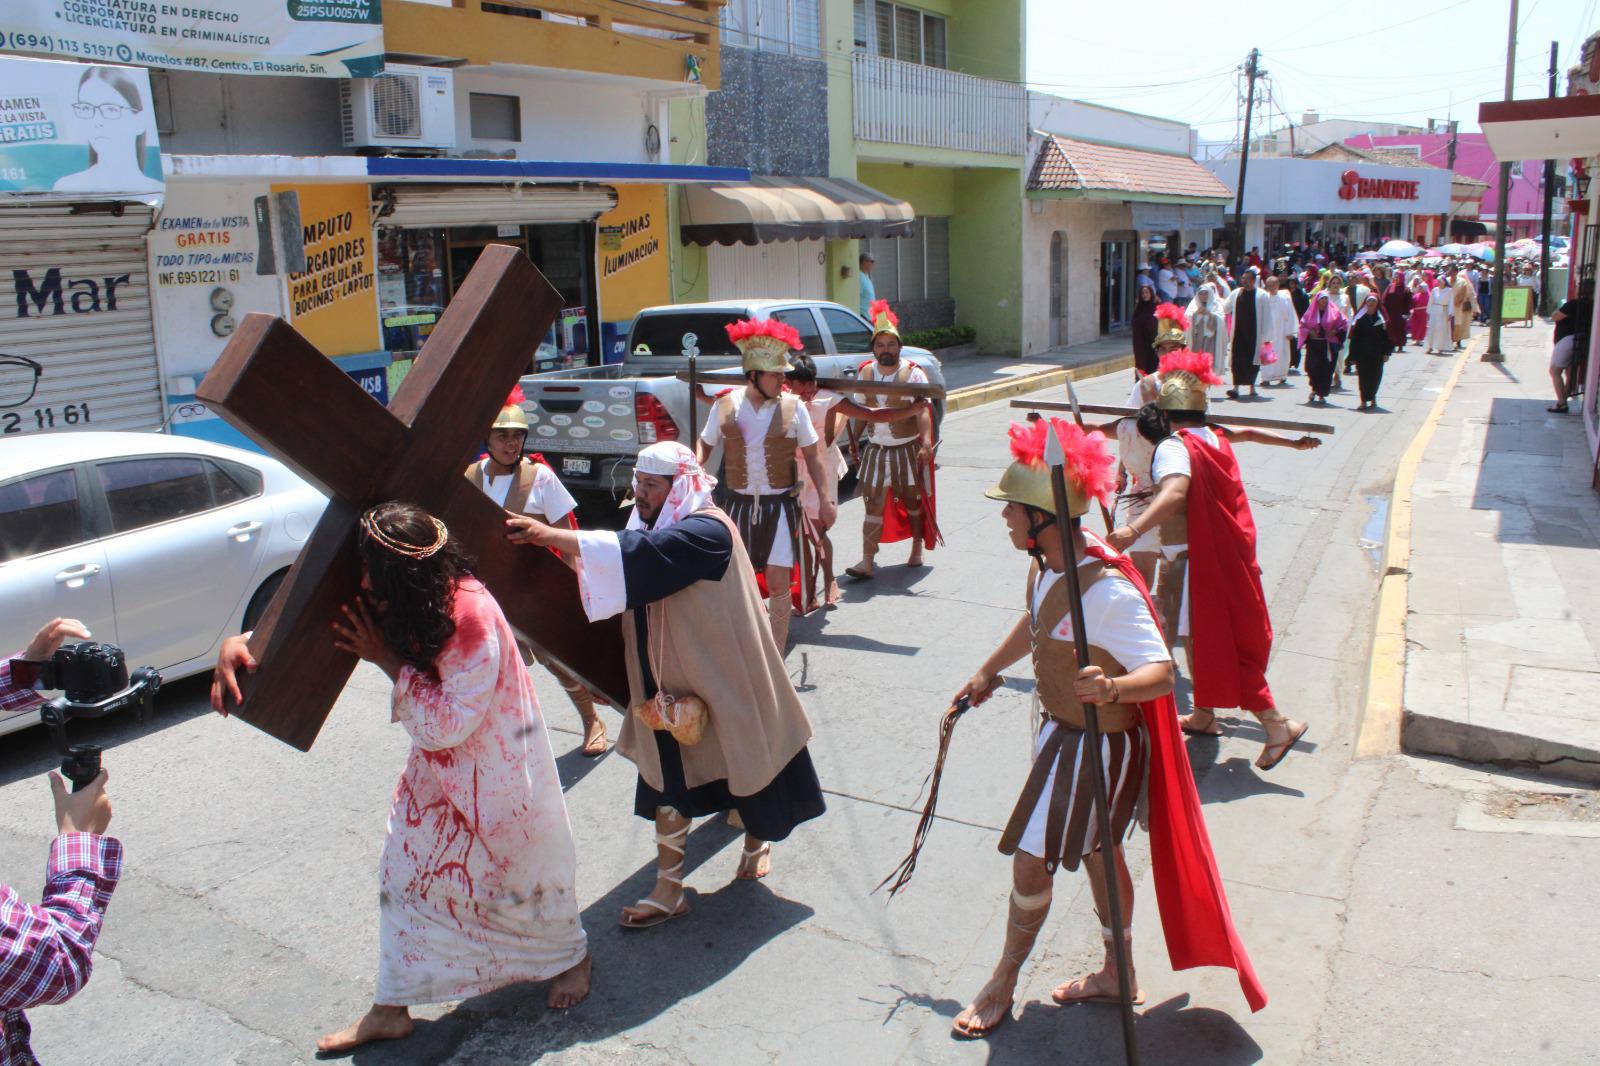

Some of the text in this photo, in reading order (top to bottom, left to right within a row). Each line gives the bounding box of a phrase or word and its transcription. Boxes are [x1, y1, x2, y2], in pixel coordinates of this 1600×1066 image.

[63, 1, 157, 24] CORPORATIVO
[161, 5, 178, 16] EN
[182, 8, 239, 23] DERECHO
[296, 5, 370, 20] 25PSU0057W
[65, 12, 270, 45] LICENCIATURA EN CRIMINALÍSTICA
[9, 32, 113, 57] (694) 113 5197
[136, 51, 182, 66] Morelos
[211, 59, 252, 72] Centro,
[253, 61, 264, 71] El
[266, 61, 308, 74] Rosario,
[5, 113, 17, 123] LA
[18, 111, 47, 122] VISTA
[162, 217, 202, 230] EXAMEN
[221, 216, 249, 228] VISTA
[303, 211, 352, 246] MPUTO
[177, 231, 231, 247] GRATIS
[157, 255, 184, 267] TODO
[188, 253, 212, 265] TIPO
[221, 252, 254, 264] MICAS
[603, 235, 659, 277] ILUMINACIÓN
[159, 272, 176, 285] INF.
[293, 261, 363, 300] PARA CELULAR
[12, 267, 130, 318] Mar
[295, 288, 334, 316] BOCINAS
[360, 375, 382, 394] USB
[64, 402, 91, 425] 61
